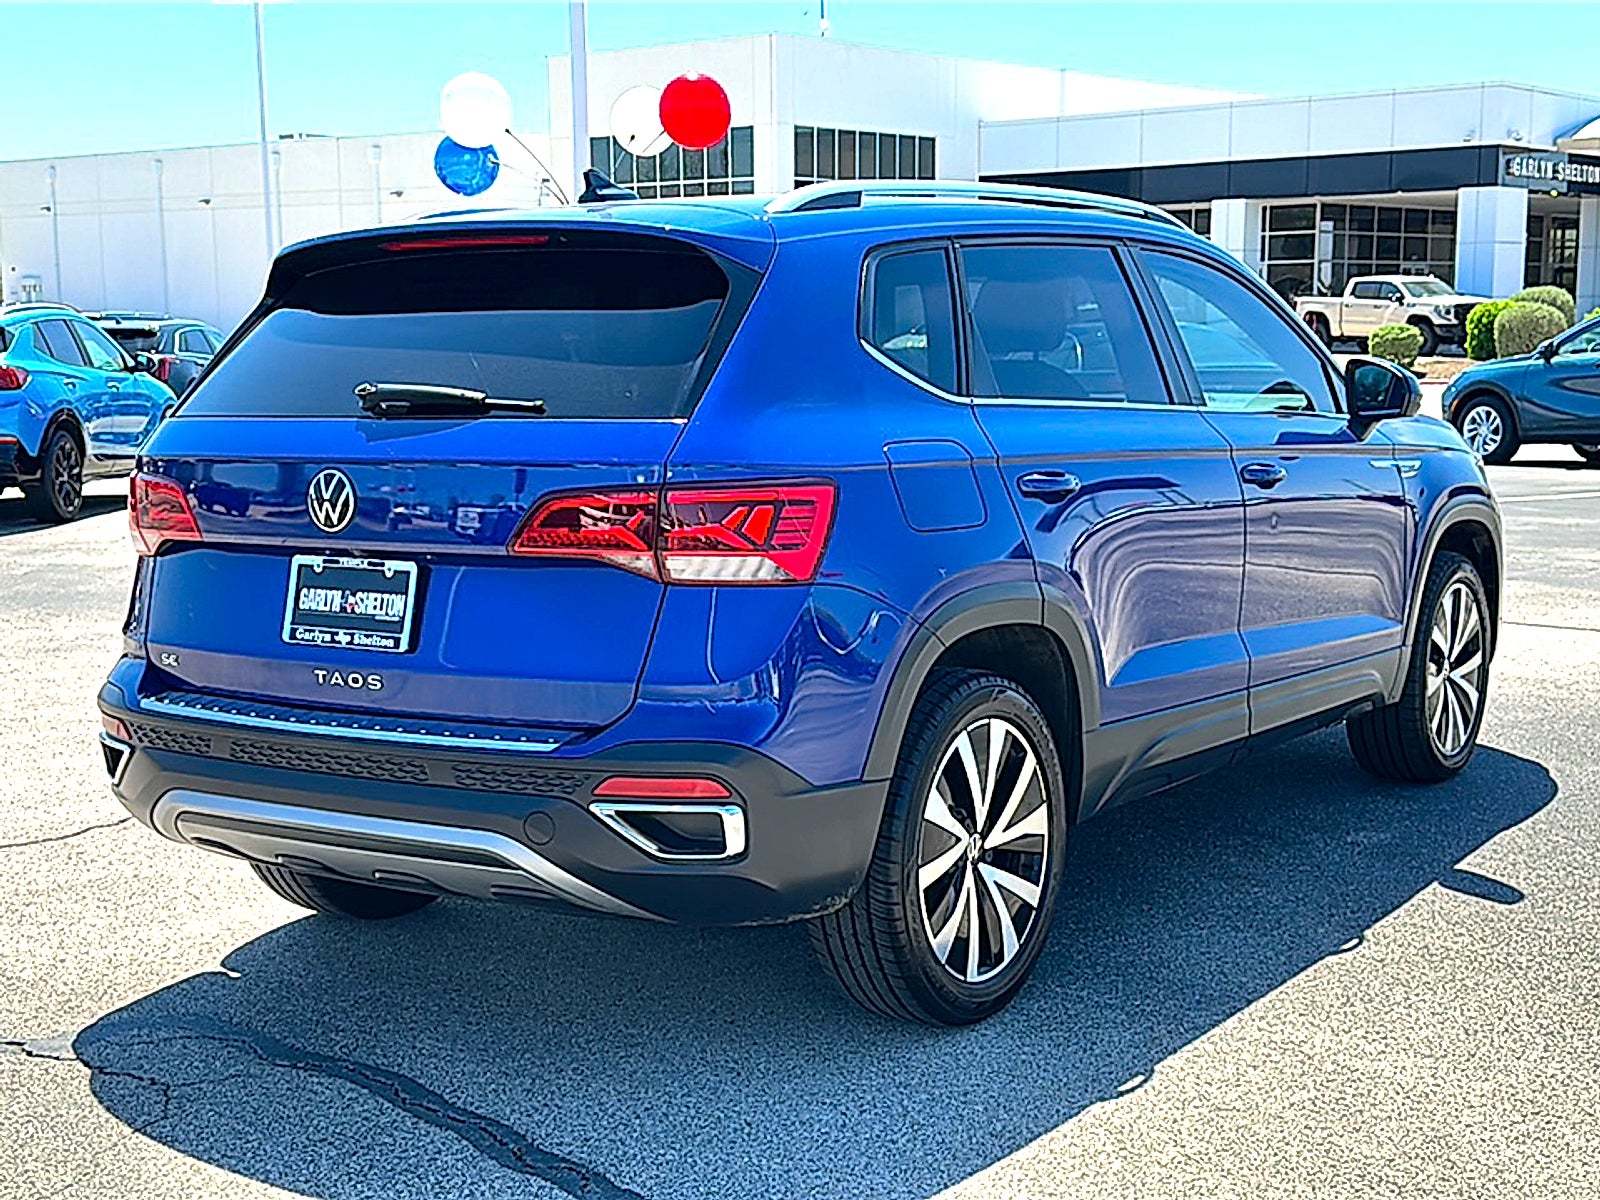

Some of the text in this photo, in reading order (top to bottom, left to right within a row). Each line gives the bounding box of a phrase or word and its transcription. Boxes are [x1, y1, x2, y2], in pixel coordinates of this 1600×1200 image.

[1510, 156, 1553, 178] GARLYN
[309, 471, 353, 530] VW
[299, 588, 406, 617] GARLYN SHELTON
[295, 628, 395, 648] Garlyn Shelton
[313, 669, 383, 690] TAOS
